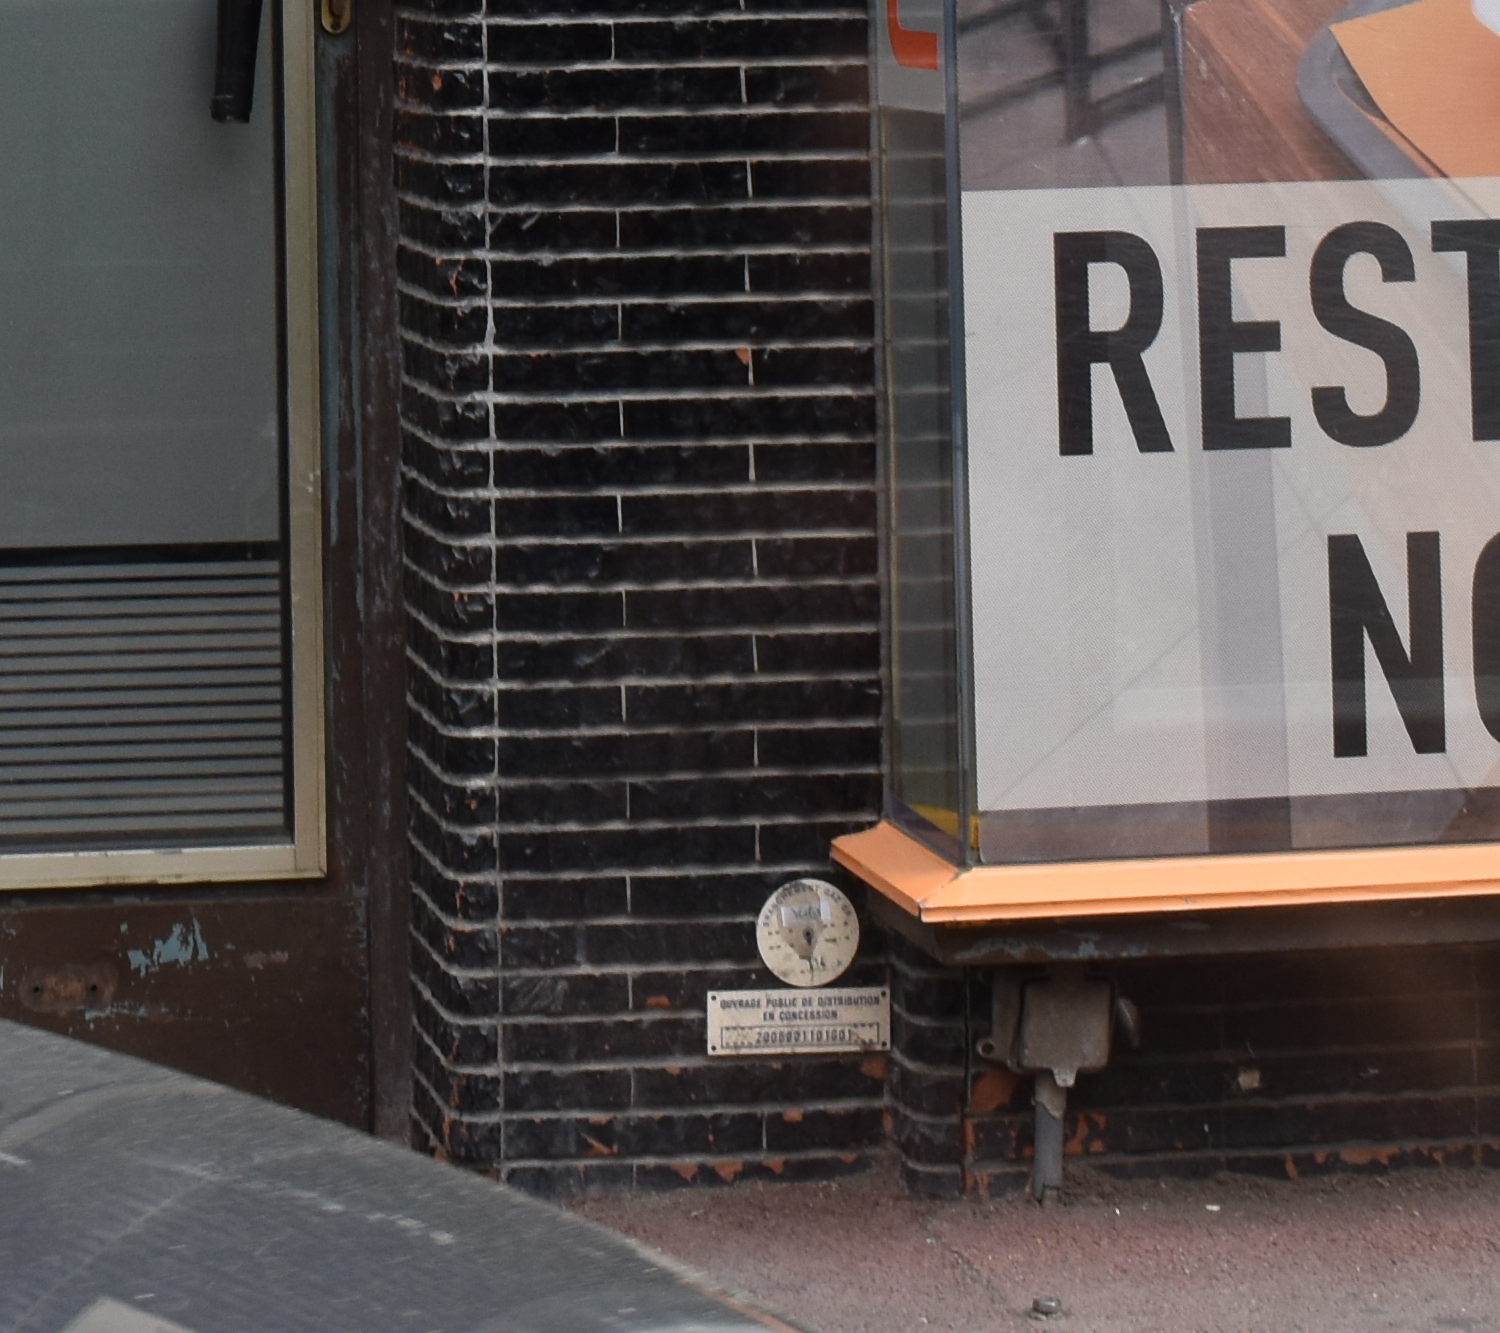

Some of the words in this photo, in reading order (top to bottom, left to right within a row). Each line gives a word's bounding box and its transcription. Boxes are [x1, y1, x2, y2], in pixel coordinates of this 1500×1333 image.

[720, 998, 762, 1010] OUVRAGE
[766, 997, 798, 1009] PUBLIC
[801, 996, 813, 1008] DE
[817, 995, 880, 1007] DISTRIBUTION
[763, 1011, 775, 1021] EN
[779, 1009, 838, 1021] CONCESSION
